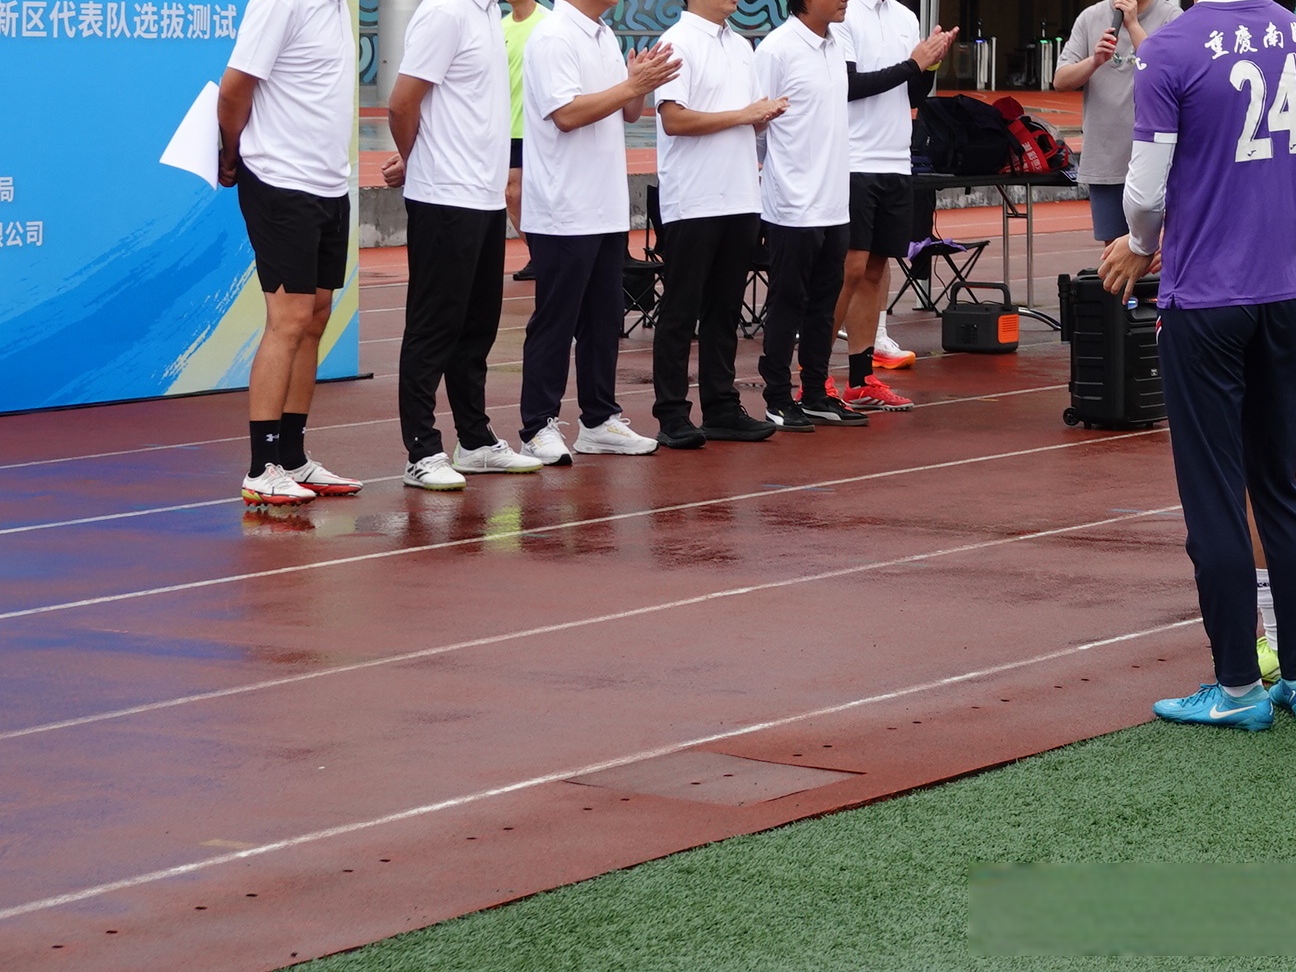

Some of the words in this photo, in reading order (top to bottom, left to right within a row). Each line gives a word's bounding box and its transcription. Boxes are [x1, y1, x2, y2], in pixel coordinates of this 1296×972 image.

[0, 0, 238, 40] 新区代表队选拔测试
[0, 221, 43, 247] 公司
